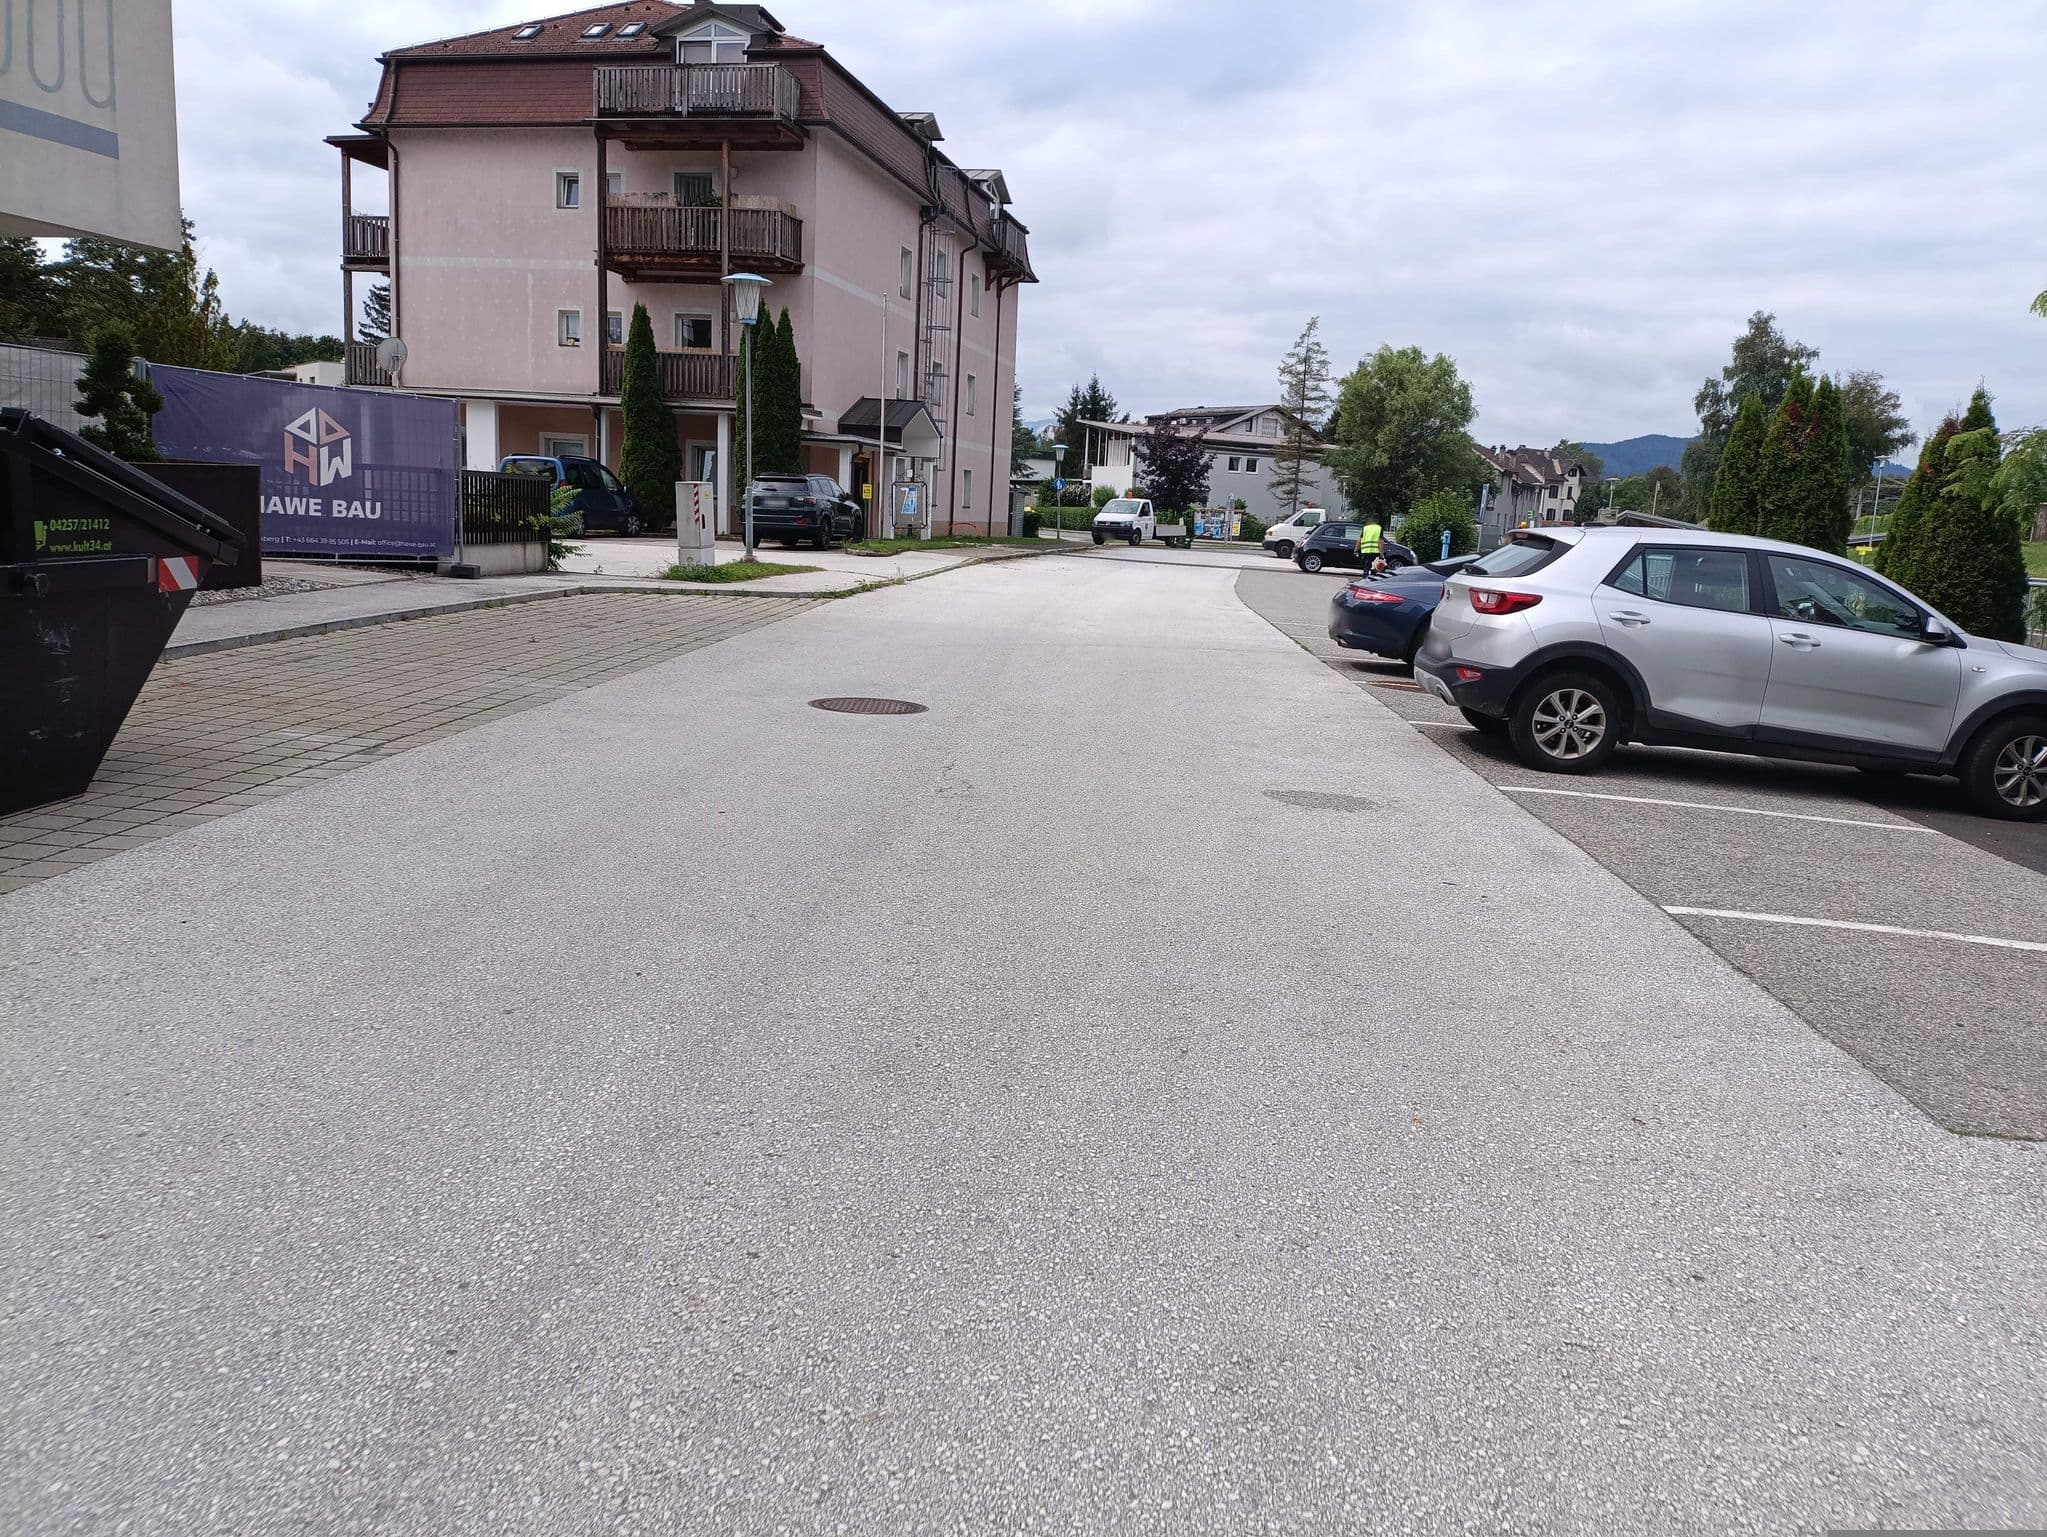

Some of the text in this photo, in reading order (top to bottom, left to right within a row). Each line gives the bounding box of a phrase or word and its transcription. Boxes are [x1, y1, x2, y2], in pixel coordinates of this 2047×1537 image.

[332, 499, 382, 519] BAU
[49, 518, 111, 532] 04257/21412
[49, 540, 113, 553] www.kult34.at
